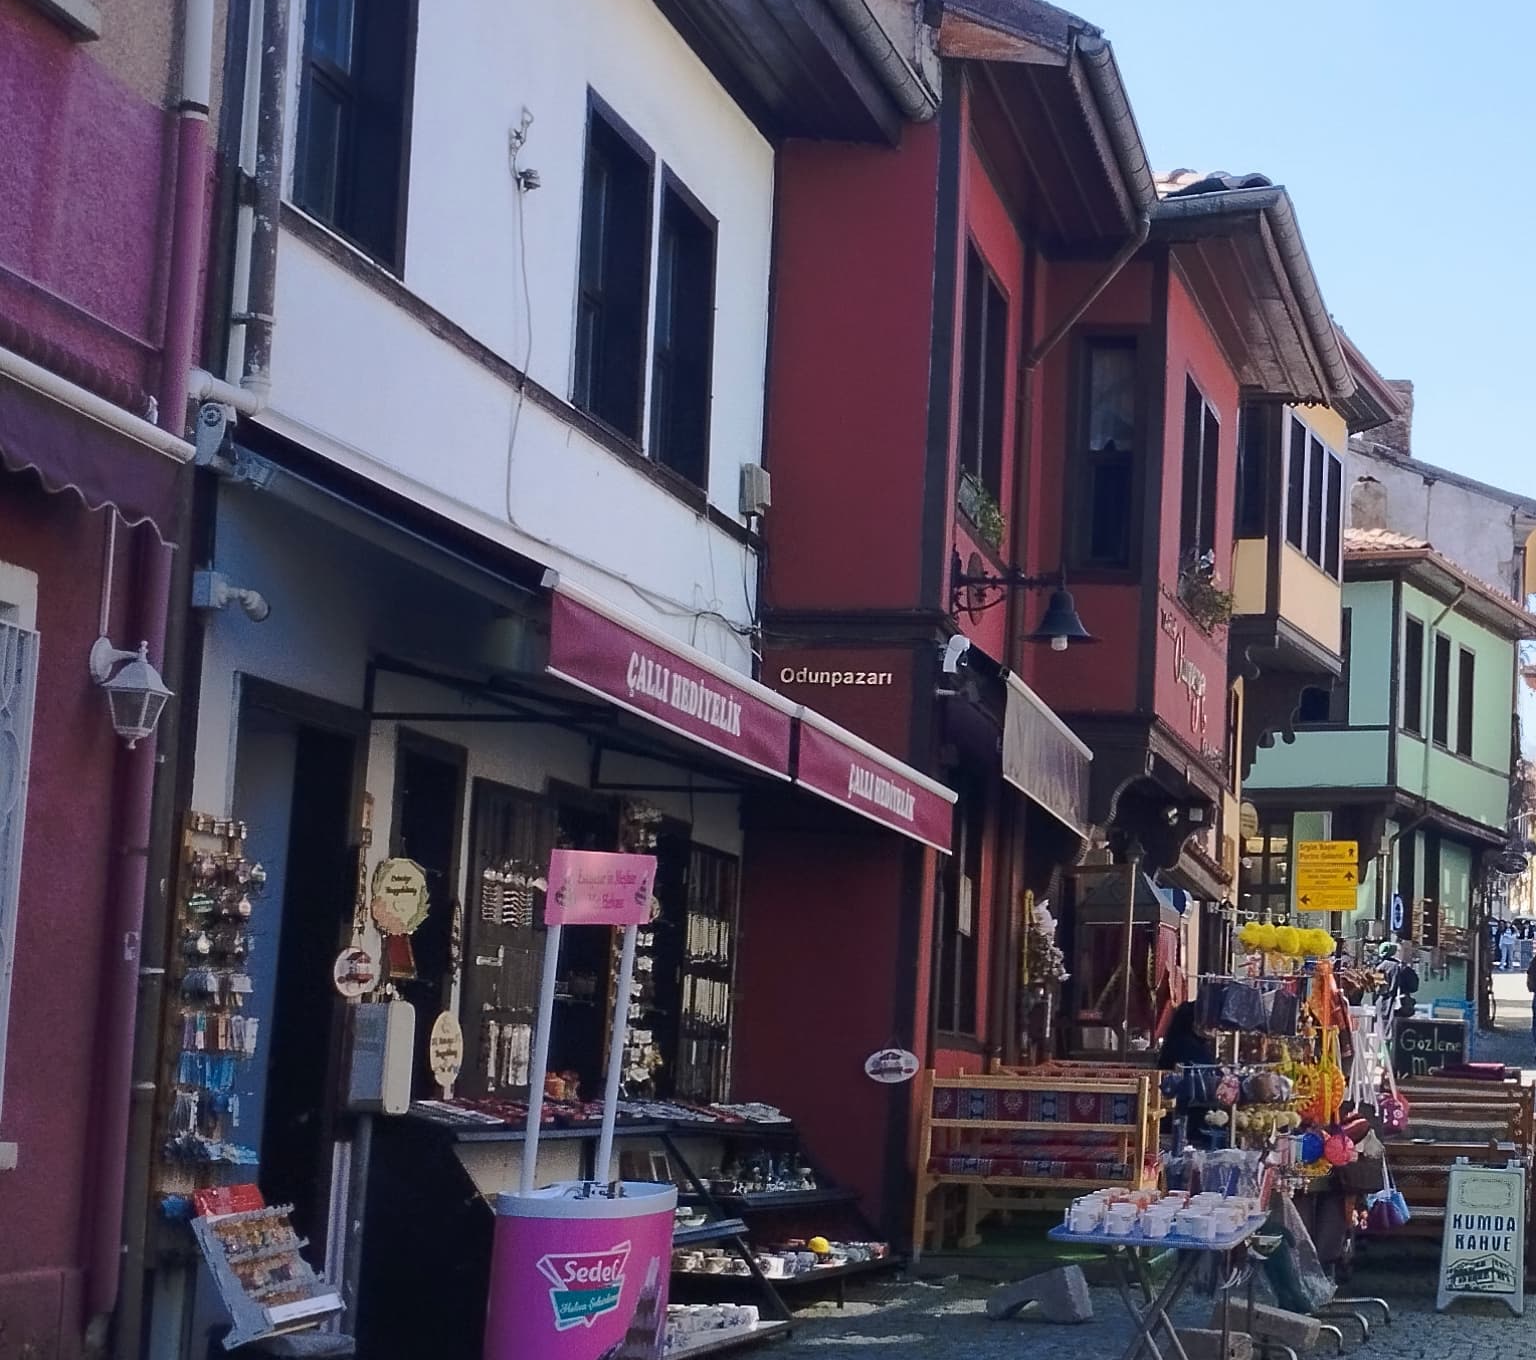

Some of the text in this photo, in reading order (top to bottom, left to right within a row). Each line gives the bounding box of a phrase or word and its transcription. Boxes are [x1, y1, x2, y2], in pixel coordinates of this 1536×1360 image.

[780, 667, 893, 687] Odunpazarı
[626, 651, 742, 737] ÇALLI HEDİYELİK
[1453, 1214, 1516, 1232] KUMDA
[1455, 1234, 1512, 1252] KAHVE
[563, 1257, 621, 1283] Sedef
